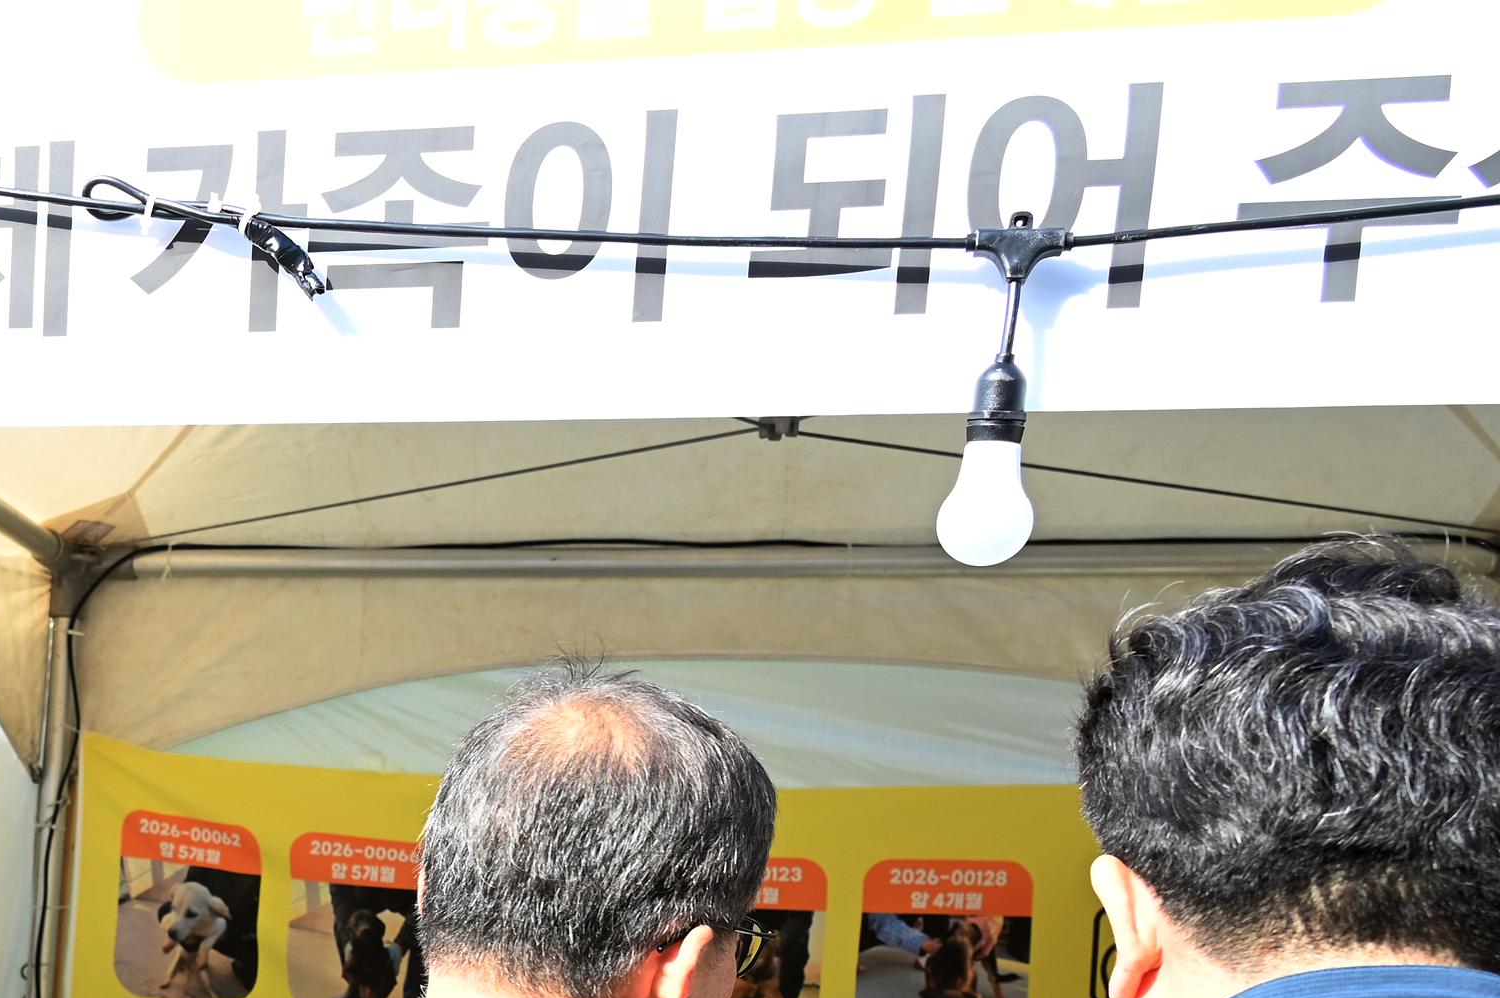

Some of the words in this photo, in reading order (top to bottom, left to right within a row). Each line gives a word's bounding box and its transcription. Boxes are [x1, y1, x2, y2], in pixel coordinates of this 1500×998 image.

[131, 109, 679, 333] 가족이
[747, 82, 1165, 316] 되어
[139, 817, 242, 848] 2026-00062
[178, 845, 221, 865] 5개월
[331, 863, 348, 879] 암
[351, 864, 396, 884] 5개월
[889, 867, 1009, 887] 2026-00128
[756, 887, 780, 905] 월
[911, 891, 931, 909] 암
[932, 892, 984, 911] 4개월
